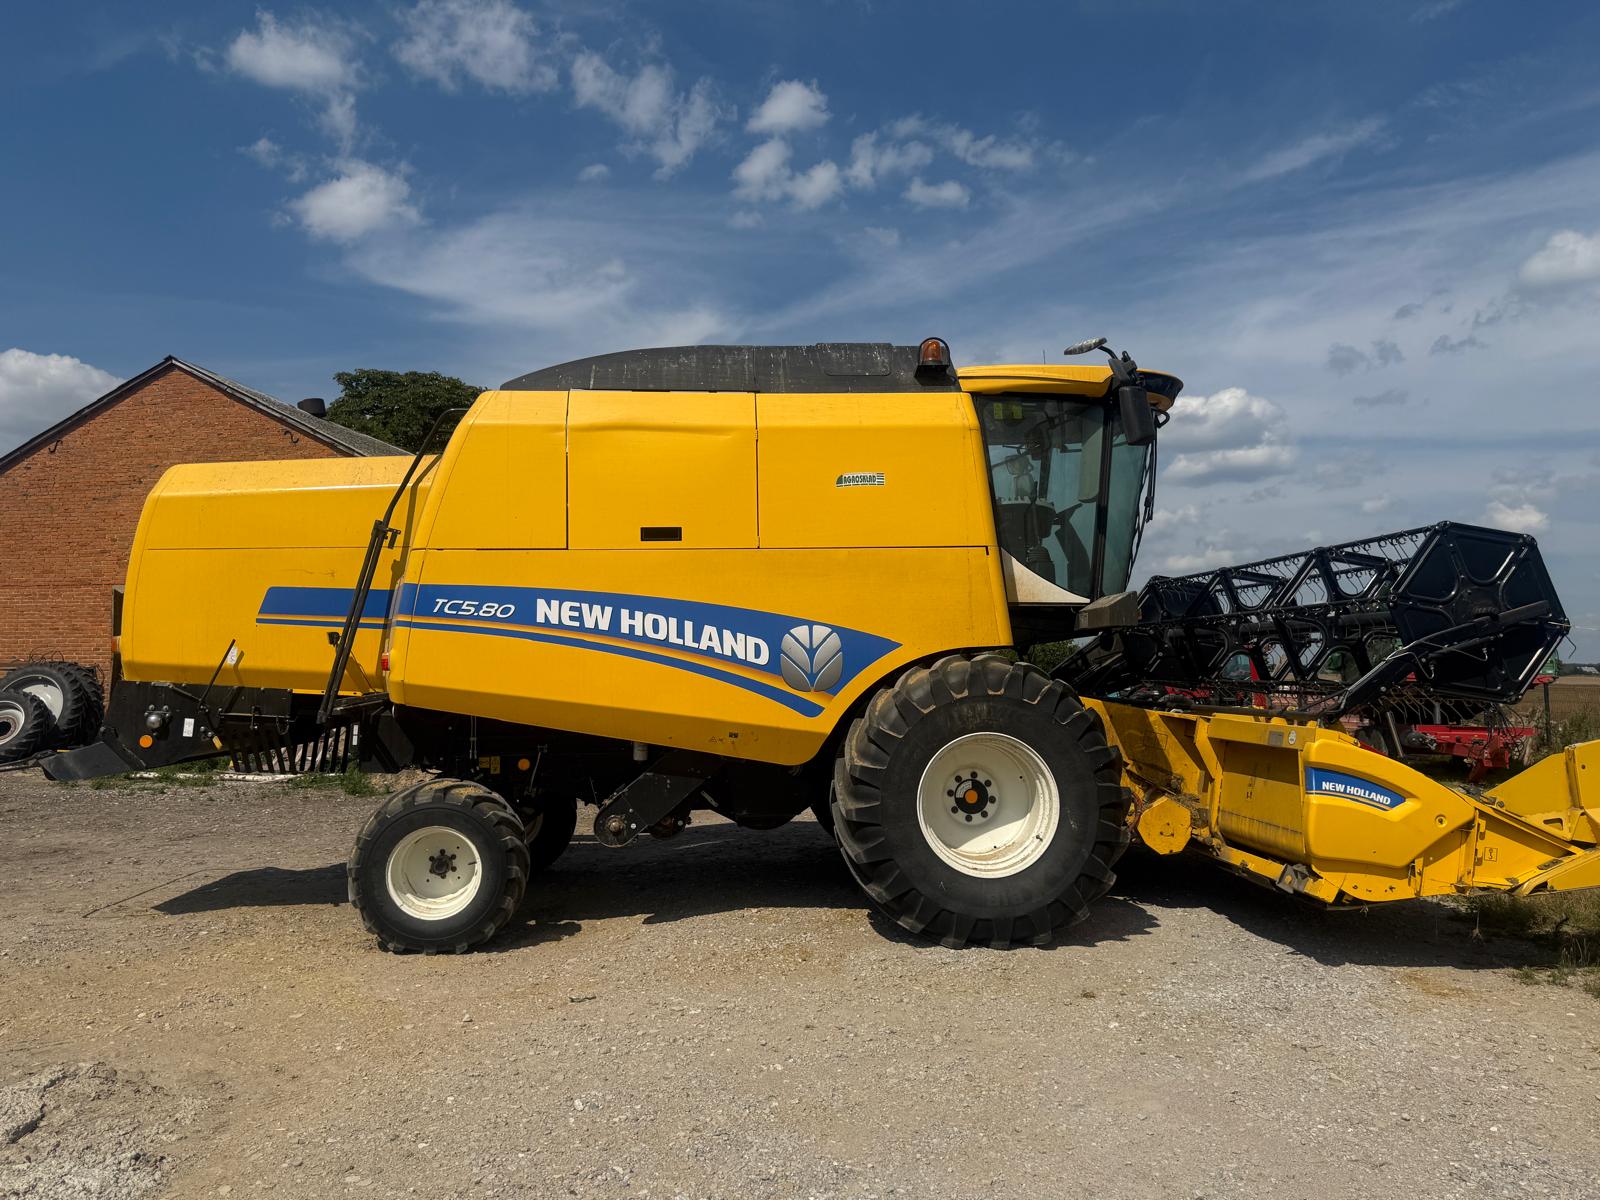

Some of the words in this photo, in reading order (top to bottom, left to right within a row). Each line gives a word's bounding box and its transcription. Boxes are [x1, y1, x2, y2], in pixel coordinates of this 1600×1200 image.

[433, 598, 514, 618] TC5.80
[536, 598, 613, 631] NEW
[620, 608, 770, 666] HOLLAND
[1322, 781, 1345, 793] NEW
[1346, 786, 1391, 805] HOLLAND
